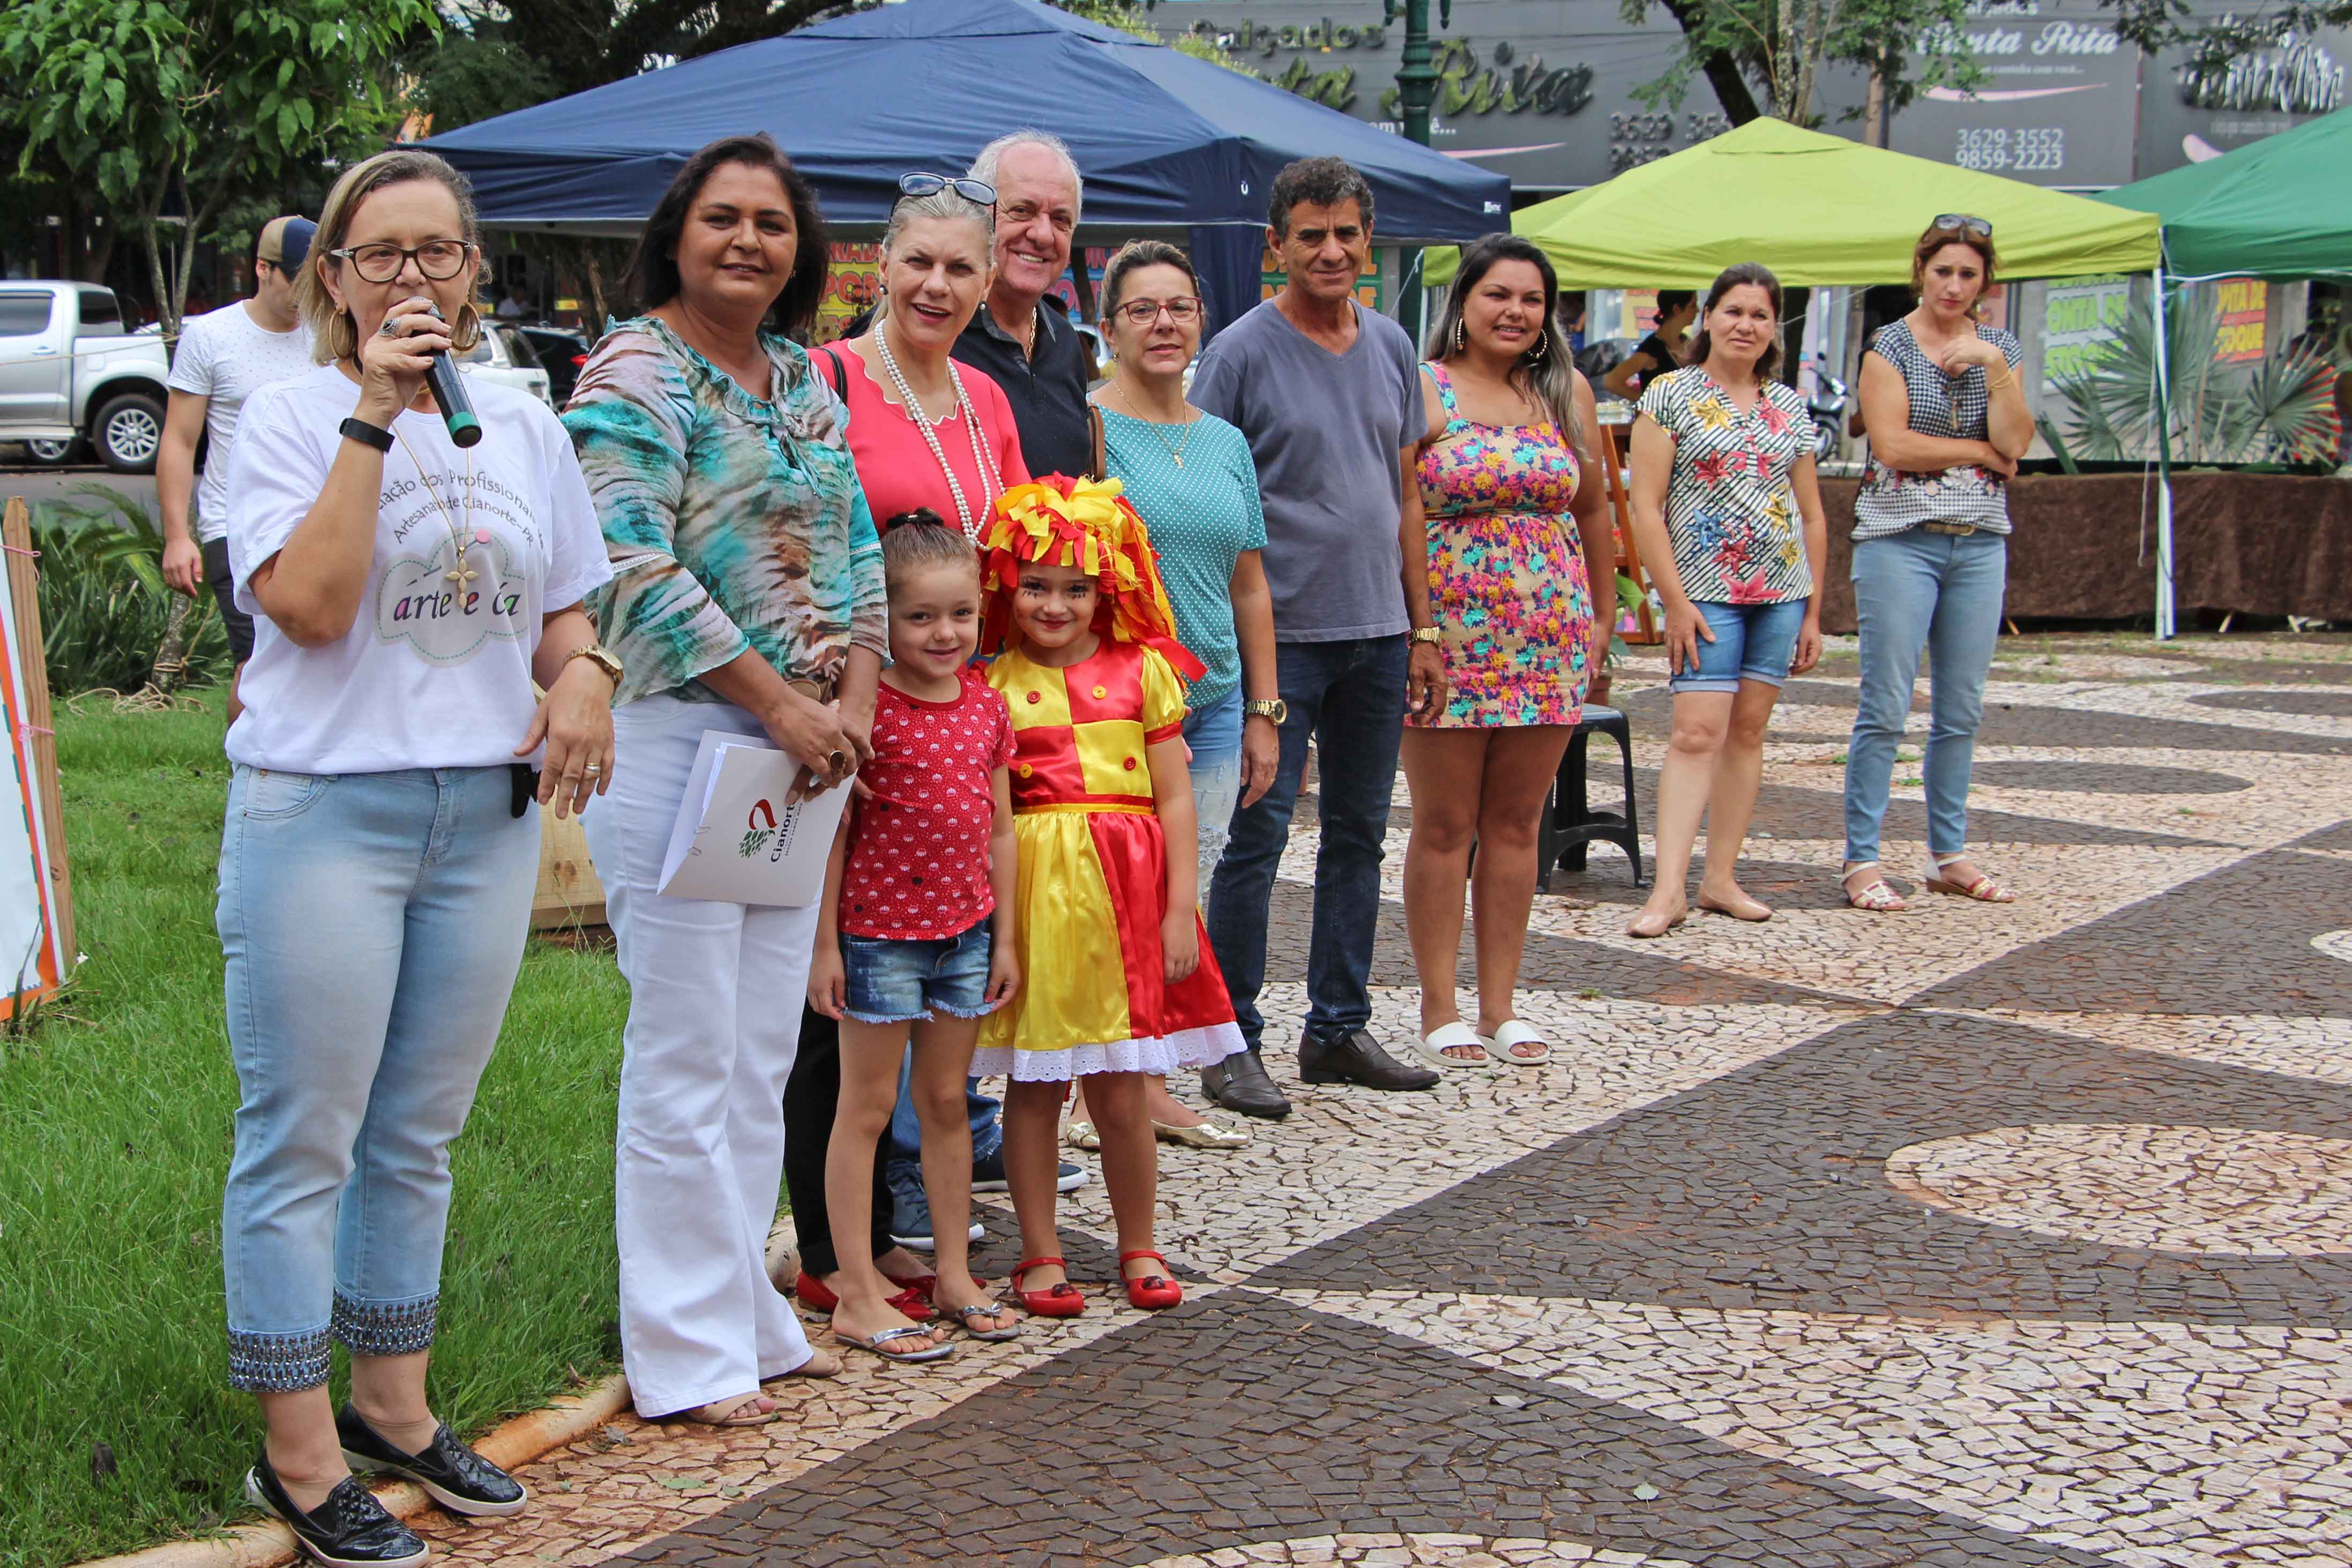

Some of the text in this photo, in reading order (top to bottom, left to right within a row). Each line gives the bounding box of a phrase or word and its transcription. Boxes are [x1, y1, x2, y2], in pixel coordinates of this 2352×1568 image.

[2030, 20, 2120, 55] Rita
[1956, 128, 2063, 148] 3629-3552
[1955, 149, 2063, 170] 9859-2223
[448, 469, 536, 525] Profissionais
[464, 591, 479, 616] e
[771, 805, 795, 862] Cianort
